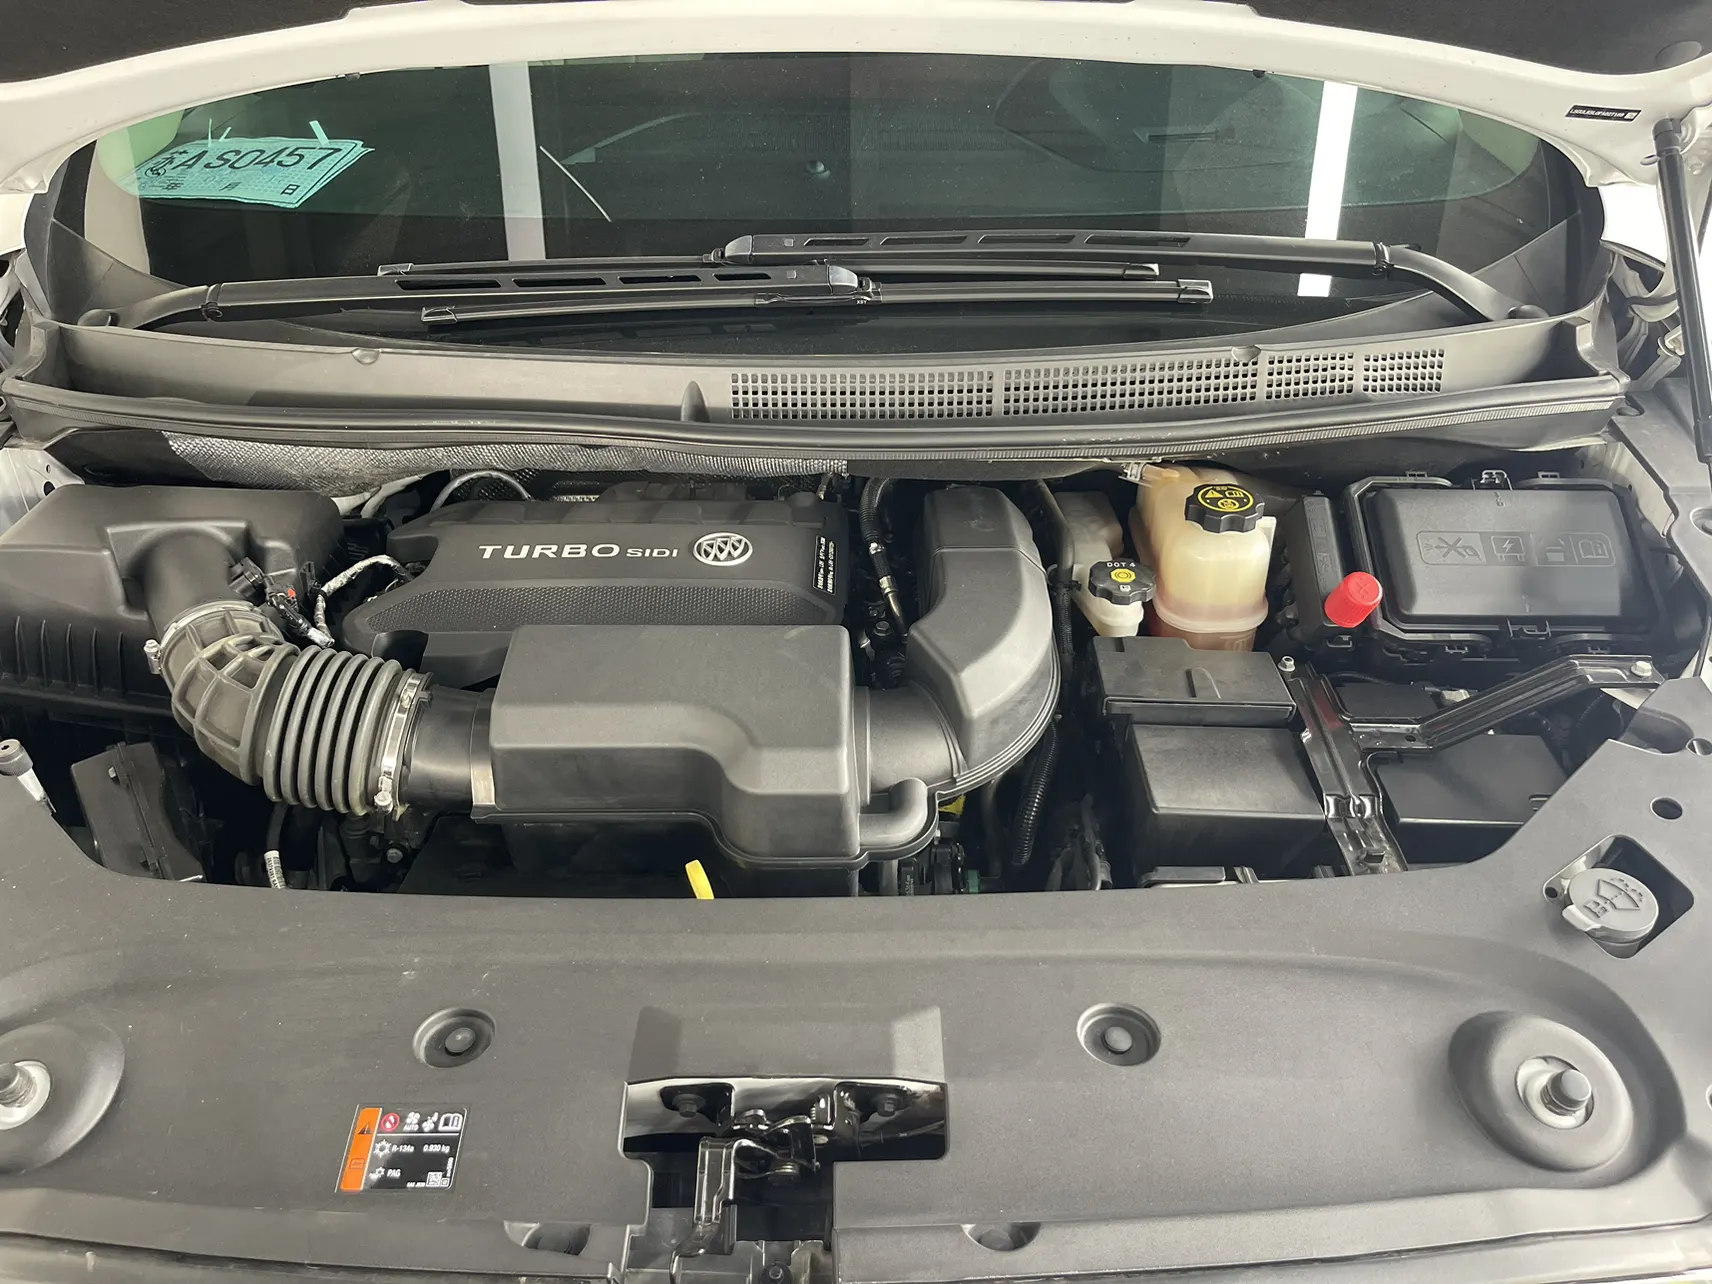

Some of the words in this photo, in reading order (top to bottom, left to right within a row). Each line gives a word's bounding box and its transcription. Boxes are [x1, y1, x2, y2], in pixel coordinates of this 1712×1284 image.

[478, 543, 620, 559] TURBO
[626, 548, 680, 558] SIDI
[422, 1144, 441, 1152] 0.930
[441, 1144, 450, 1154] kg
[386, 1169, 401, 1177] PAG
